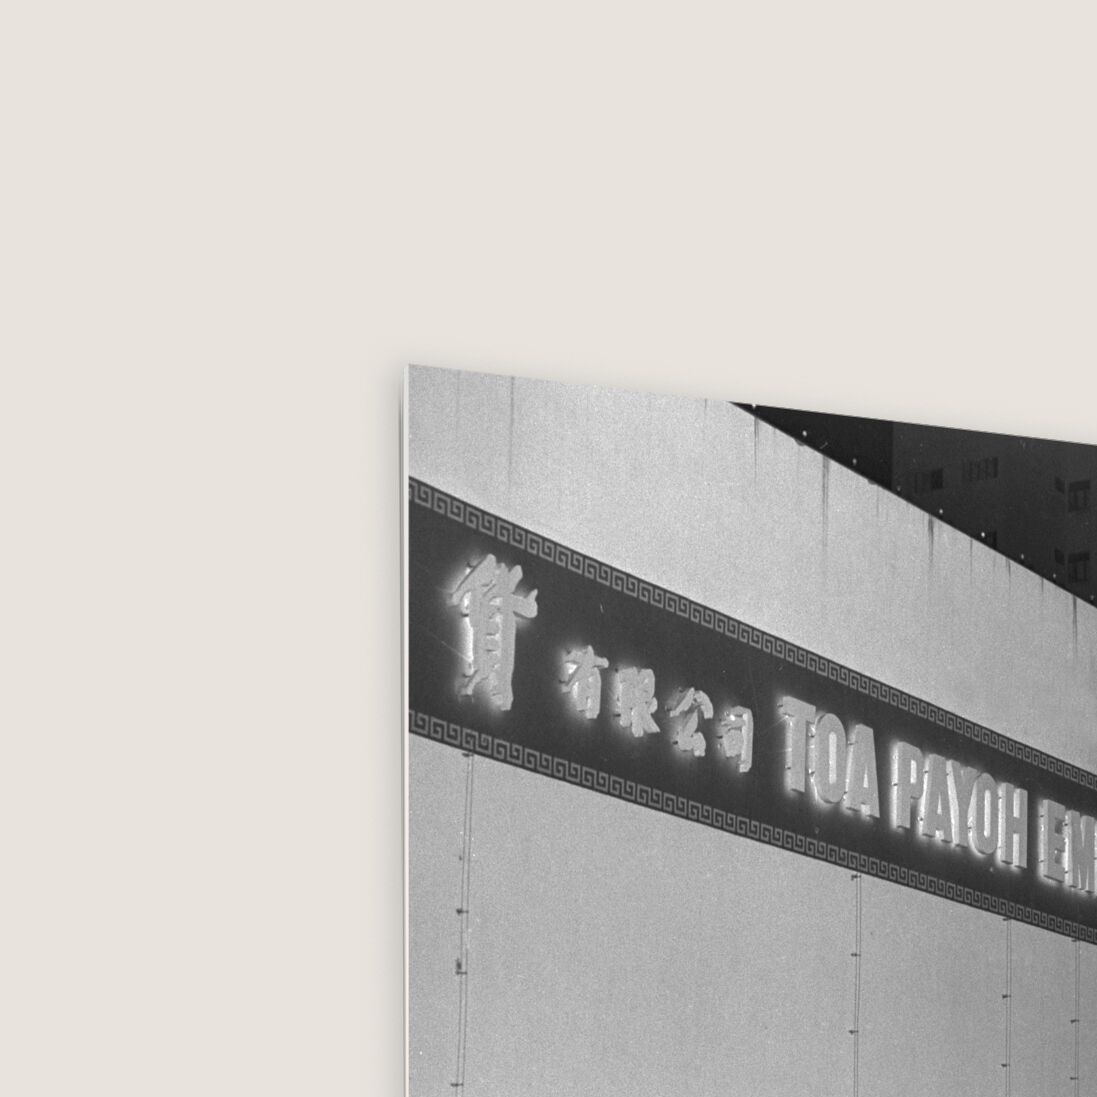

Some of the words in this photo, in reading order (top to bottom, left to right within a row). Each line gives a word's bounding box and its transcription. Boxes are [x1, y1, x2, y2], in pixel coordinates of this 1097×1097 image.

[560, 644, 754, 774] 有限公司
[778, 694, 880, 821] TOA
[890, 739, 1030, 871] PAYOH
